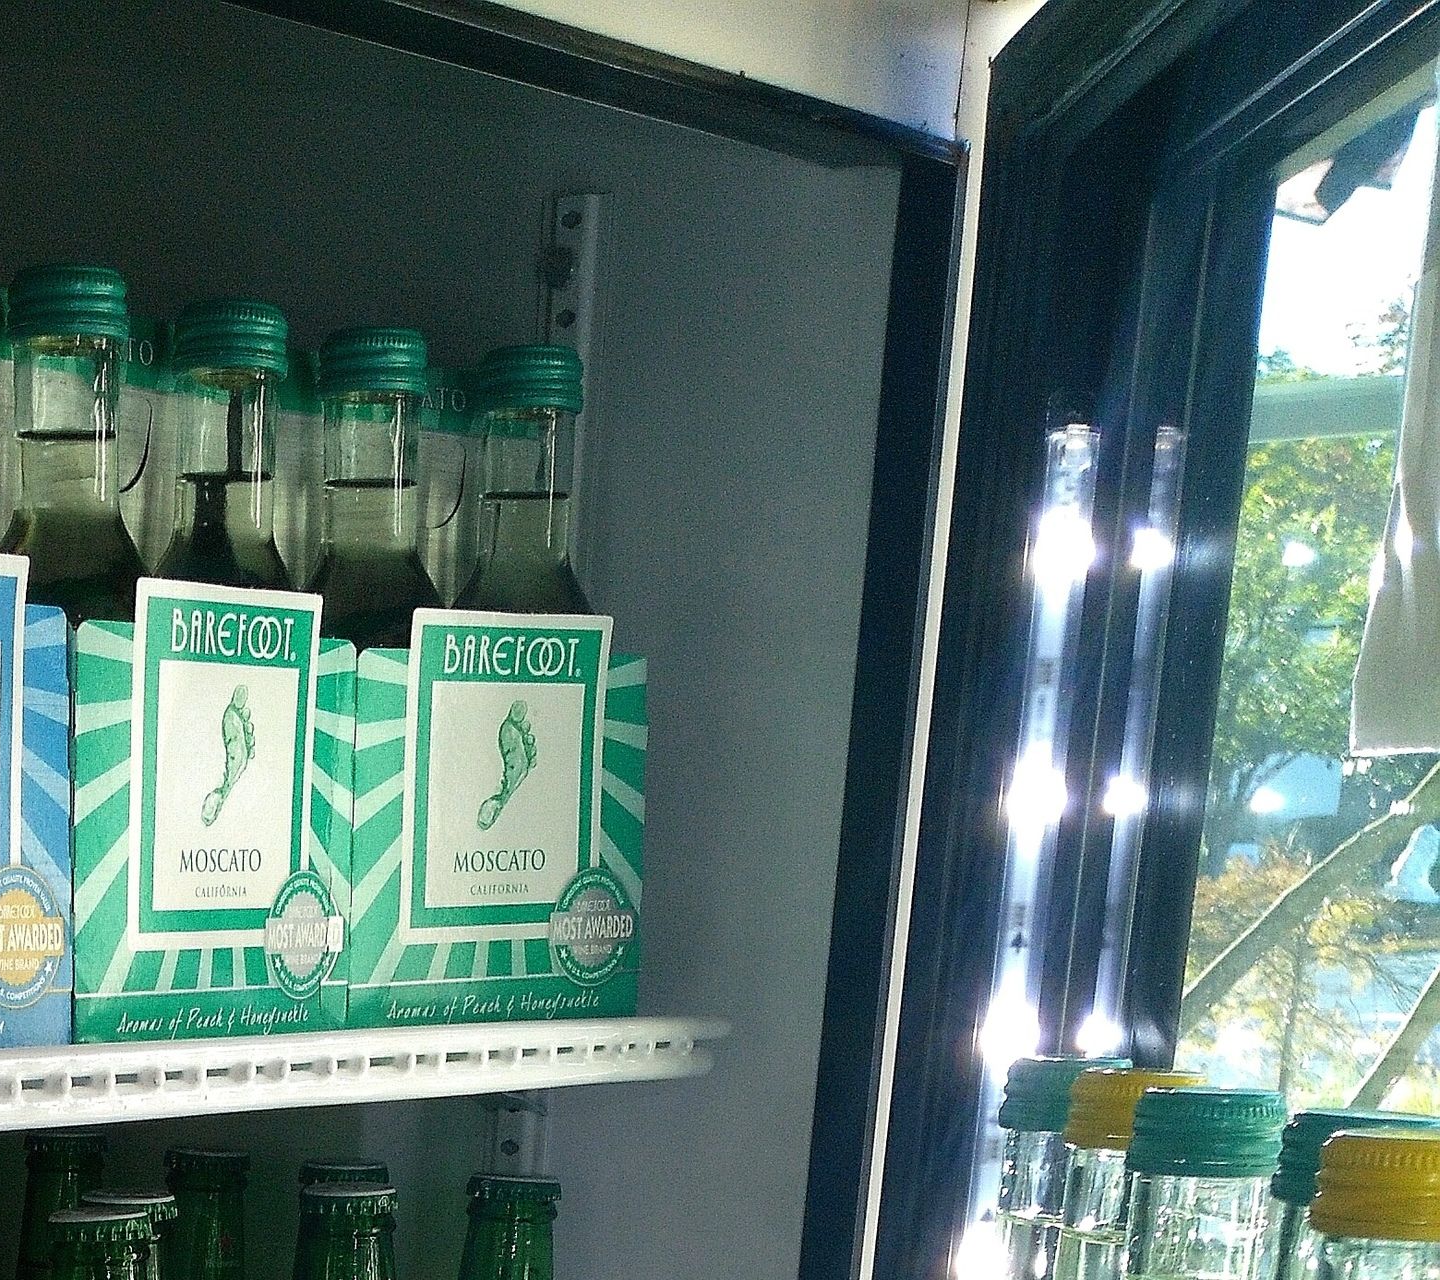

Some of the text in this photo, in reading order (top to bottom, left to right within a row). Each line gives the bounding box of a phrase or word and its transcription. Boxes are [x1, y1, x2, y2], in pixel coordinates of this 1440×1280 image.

[171, 607, 292, 661] BAREFOOT
[444, 634, 578, 678] BAREFOOT
[179, 848, 262, 873] MOSCATO
[453, 848, 546, 872] MOSCATO
[195, 883, 248, 898] CALIFORNIA
[469, 881, 529, 896] CALIFORNIA
[8, 922, 62, 952] AWARDED
[554, 914, 633, 941] MOST AWARDED
[117, 1012, 163, 1035] Aromas
[168, 1008, 181, 1033] of
[188, 1008, 222, 1031] Peach
[240, 1005, 310, 1033] Honeysuckle
[387, 998, 437, 1021] Aromas
[447, 995, 459, 1022] of
[462, 994, 501, 1015] Peach
[520, 991, 600, 1019] Honeysuckle
